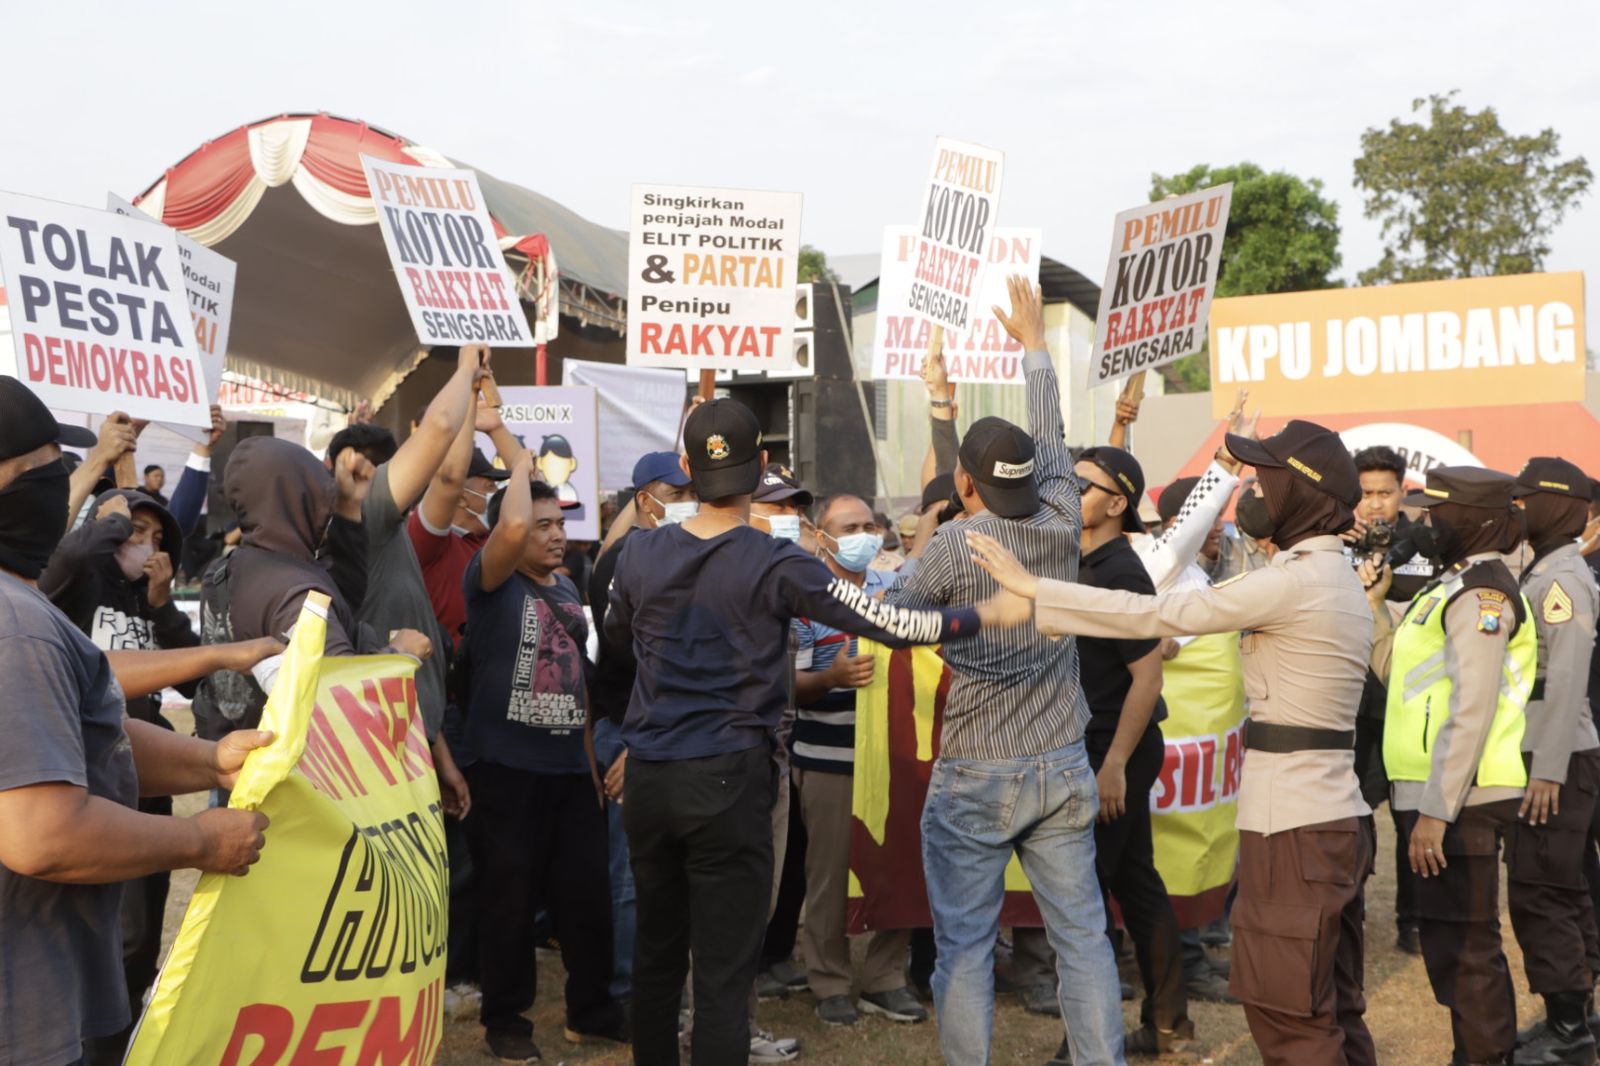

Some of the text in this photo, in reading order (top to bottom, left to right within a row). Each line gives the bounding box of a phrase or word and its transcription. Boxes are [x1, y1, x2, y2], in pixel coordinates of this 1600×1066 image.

[372, 168, 476, 211] PEMILU
[934, 149, 997, 193] PEMILU
[643, 194, 744, 210] Singkirkan
[643, 213, 784, 230] penjajah Modal
[922, 183, 990, 254] KOTOR
[1121, 196, 1223, 252] PEMILU
[7, 216, 169, 291] TOLAK
[384, 206, 496, 269] KOTOR
[643, 232, 783, 251] ELIT POLITIK
[897, 235, 1032, 264] PON
[405, 267, 510, 311] RAKYAT
[641, 253, 784, 289] & PARTAI
[915, 241, 980, 297] RAKYAT
[1110, 232, 1213, 310] KOTOR
[19, 275, 183, 347] PESTA
[422, 310, 523, 341] SENGSARA
[641, 295, 730, 318] Penipu
[909, 283, 968, 329] SENGSARA
[1104, 287, 1206, 351] RAKYAT
[640, 322, 781, 357] RAKYAT
[1099, 328, 1194, 380] SENGSARA
[1217, 301, 1576, 383] KPU JOMBANG
[24, 333, 199, 404] DEMOKRASI
[885, 352, 1019, 380] PILANKU
[561, 407, 571, 421] X
[515, 646, 535, 685] THREE
[536, 692, 575, 702] WHO
